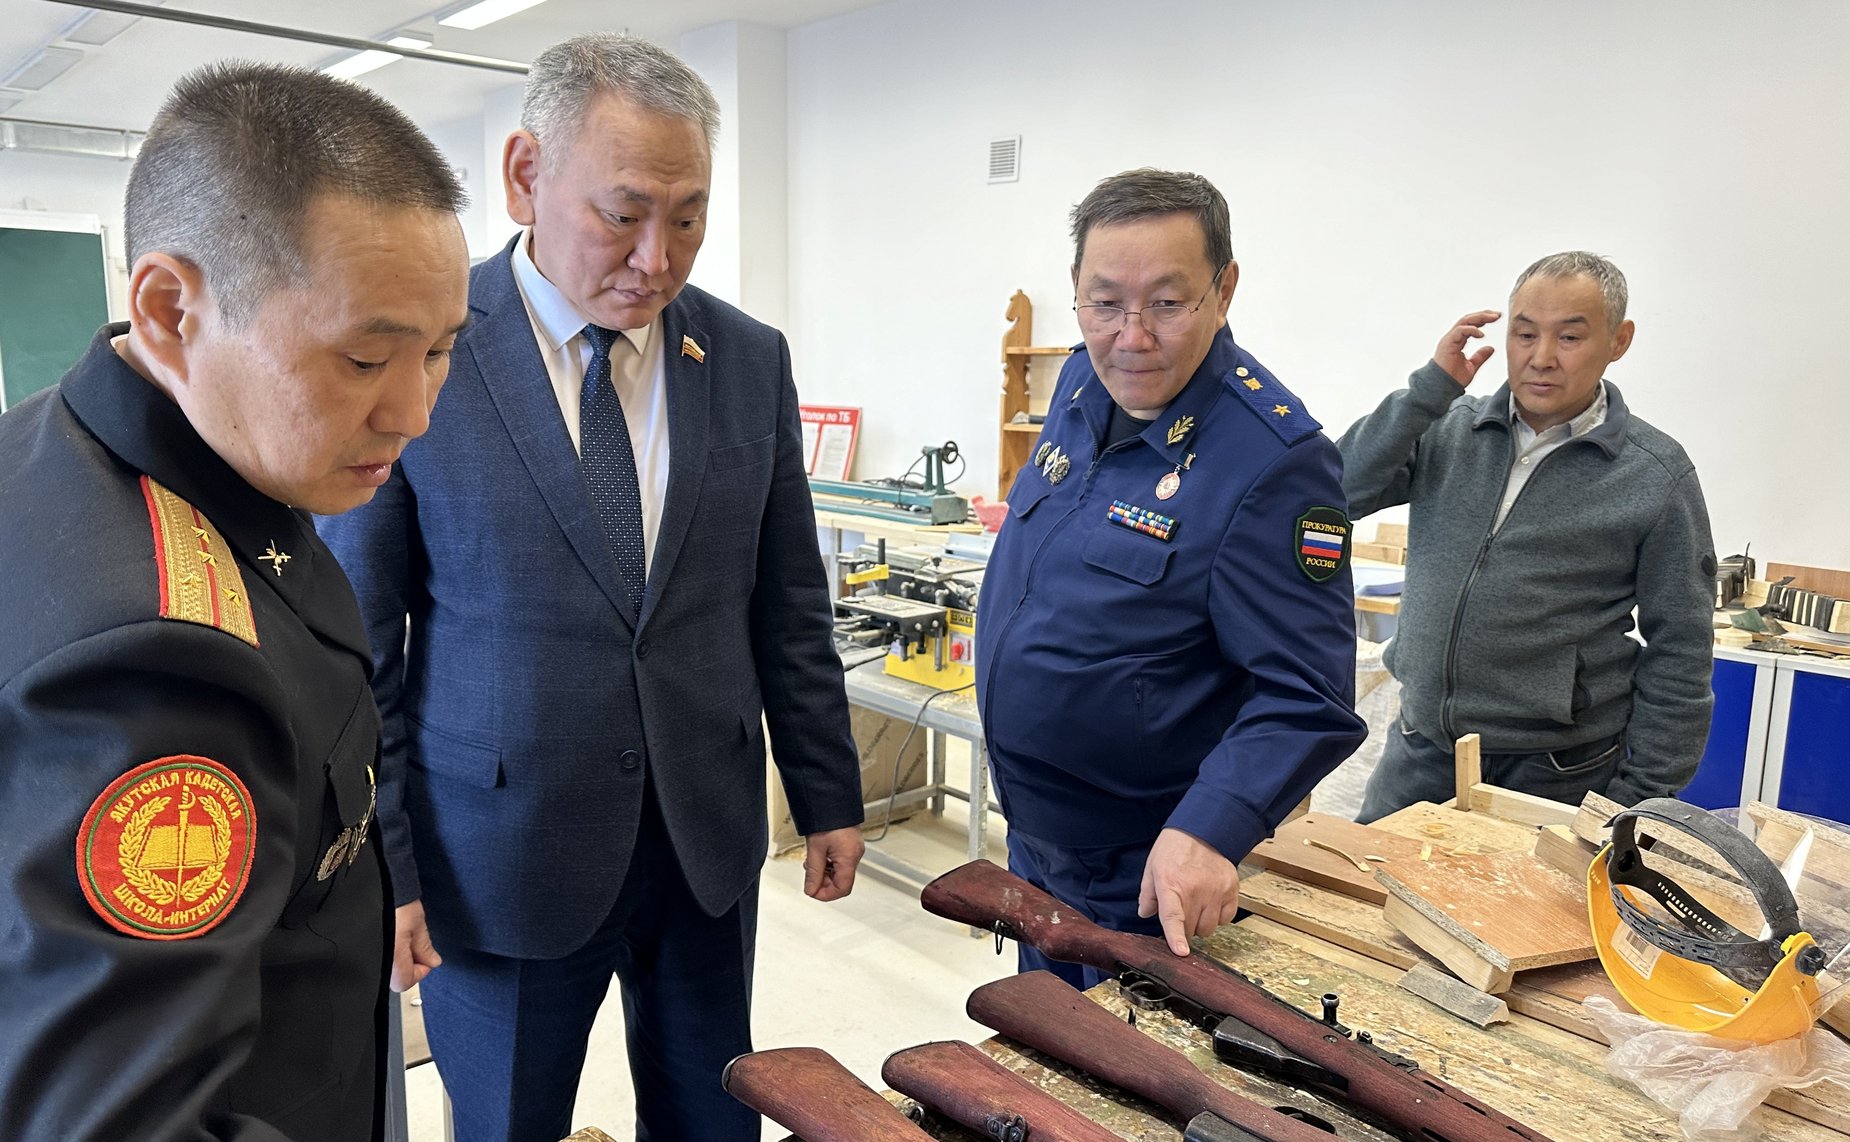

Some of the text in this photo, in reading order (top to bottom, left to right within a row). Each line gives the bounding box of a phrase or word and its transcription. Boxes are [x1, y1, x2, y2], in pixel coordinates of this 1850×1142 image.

[826, 412, 837, 422] по
[839, 411, 850, 423] ТБ
[1302, 520, 1346, 534] ПРОКУРАТУРА
[1306, 557, 1336, 568] РОССИИ
[110, 771, 242, 823] ЯКУТСКАЯ КАДЕТСКАЯ
[113, 877, 231, 925] ШКОЛА-ИНТЕРНАТ
